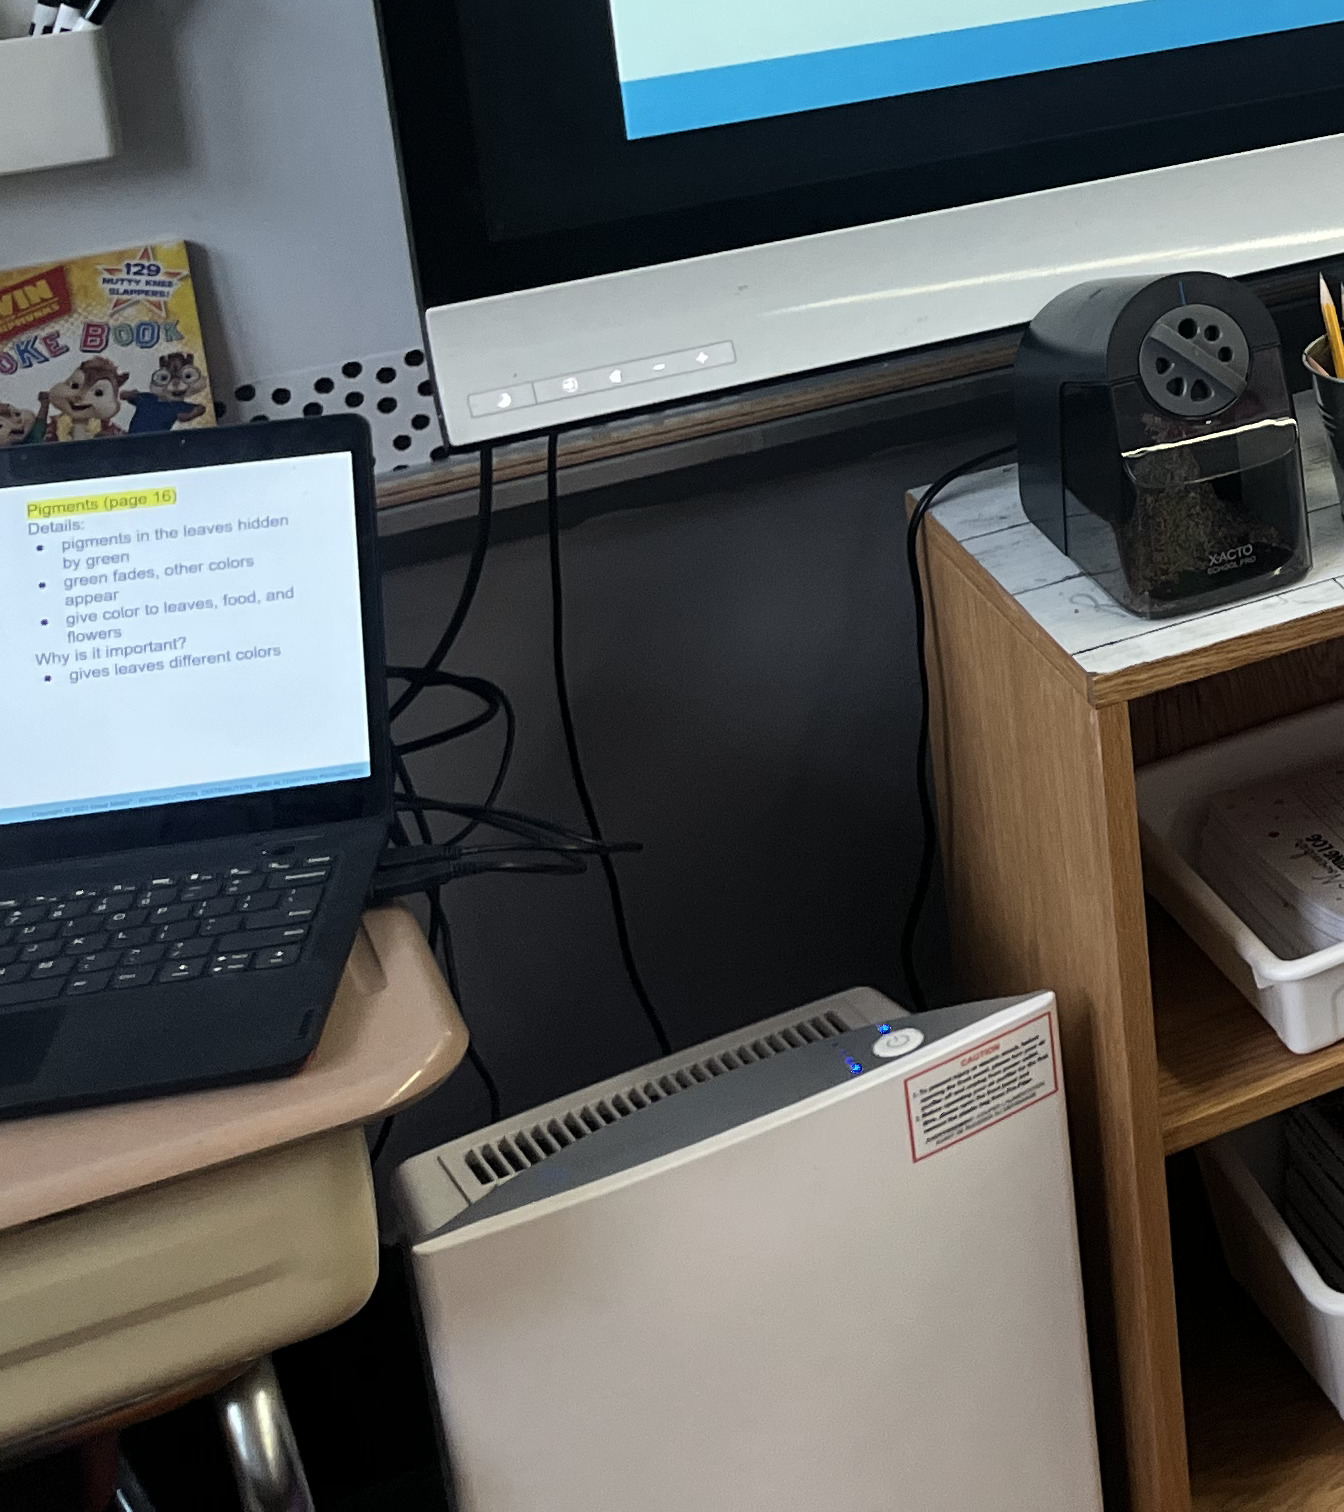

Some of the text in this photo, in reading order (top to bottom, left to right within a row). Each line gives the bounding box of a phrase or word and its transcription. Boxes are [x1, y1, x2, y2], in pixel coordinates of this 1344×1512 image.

[124, 262, 161, 276] 129
[80, 320, 185, 353] BOOK
[27, 496, 98, 517] Pigments
[960, 1044, 1000, 1067] CAUTION
